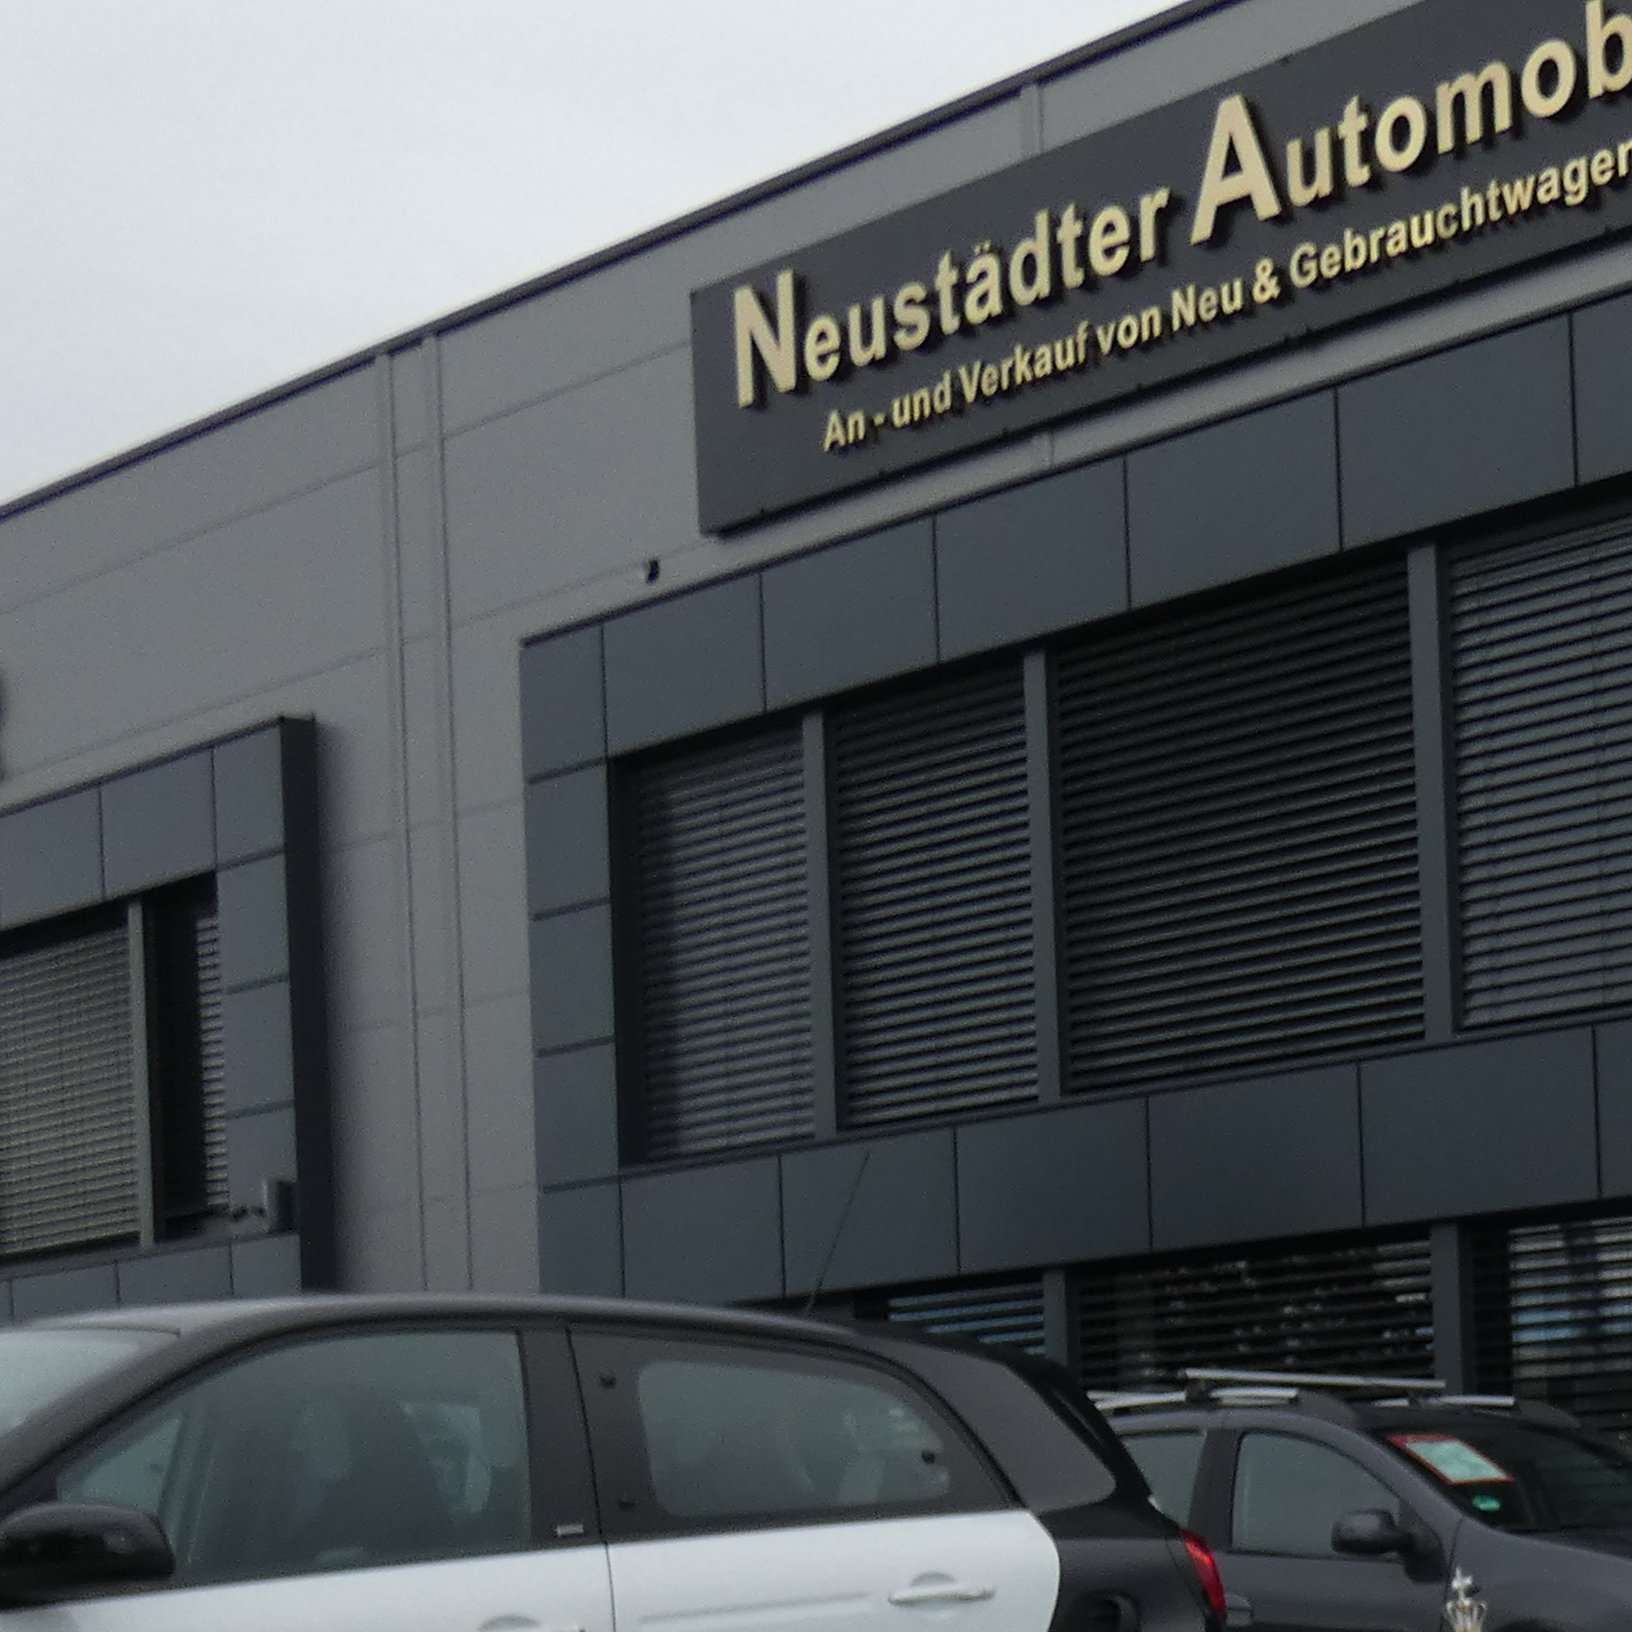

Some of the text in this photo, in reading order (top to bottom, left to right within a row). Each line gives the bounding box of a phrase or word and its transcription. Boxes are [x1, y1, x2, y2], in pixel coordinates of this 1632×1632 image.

[733, 184, 1171, 408] Neustädter
[821, 409, 866, 453] An
[893, 370, 953, 430] und
[957, 320, 1088, 405] Verkauf
[1097, 306, 1162, 357] von
[1171, 277, 1243, 332] Neu
[1251, 258, 1281, 304] &
